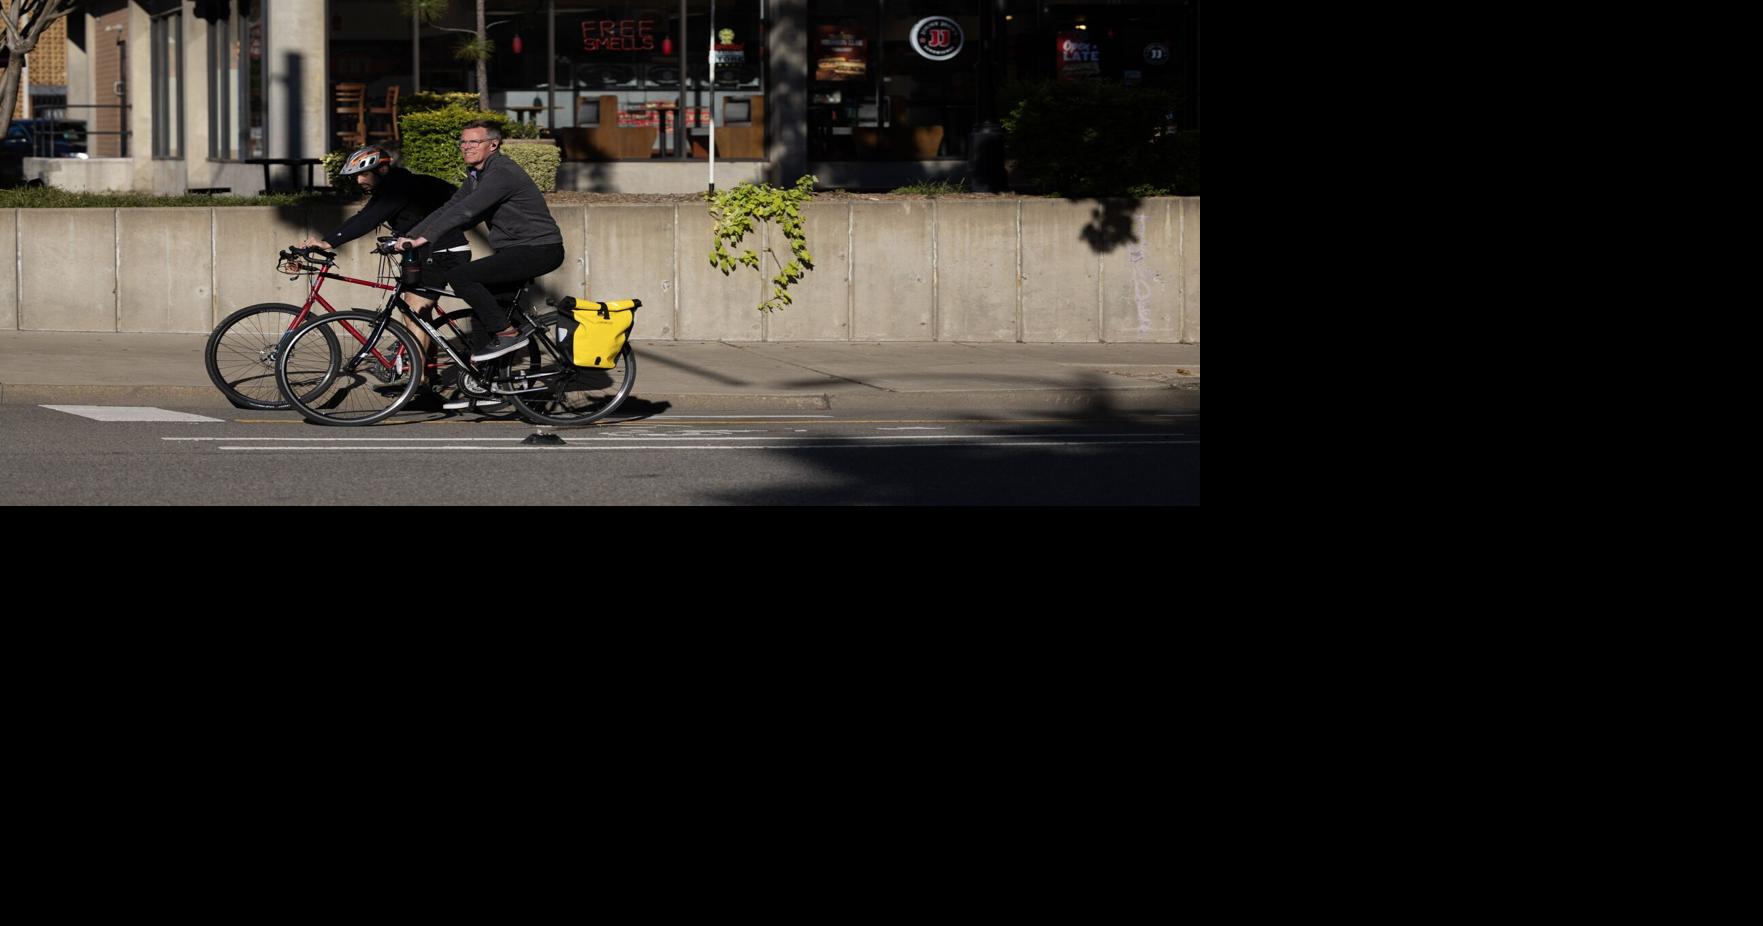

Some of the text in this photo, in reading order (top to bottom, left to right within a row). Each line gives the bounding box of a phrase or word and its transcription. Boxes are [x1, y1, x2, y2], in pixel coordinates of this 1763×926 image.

[581, 20, 654, 38] FREE
[583, 38, 655, 51] SMELLS
[927, 28, 951, 48] JJ
[1063, 50, 1101, 62] LATE
